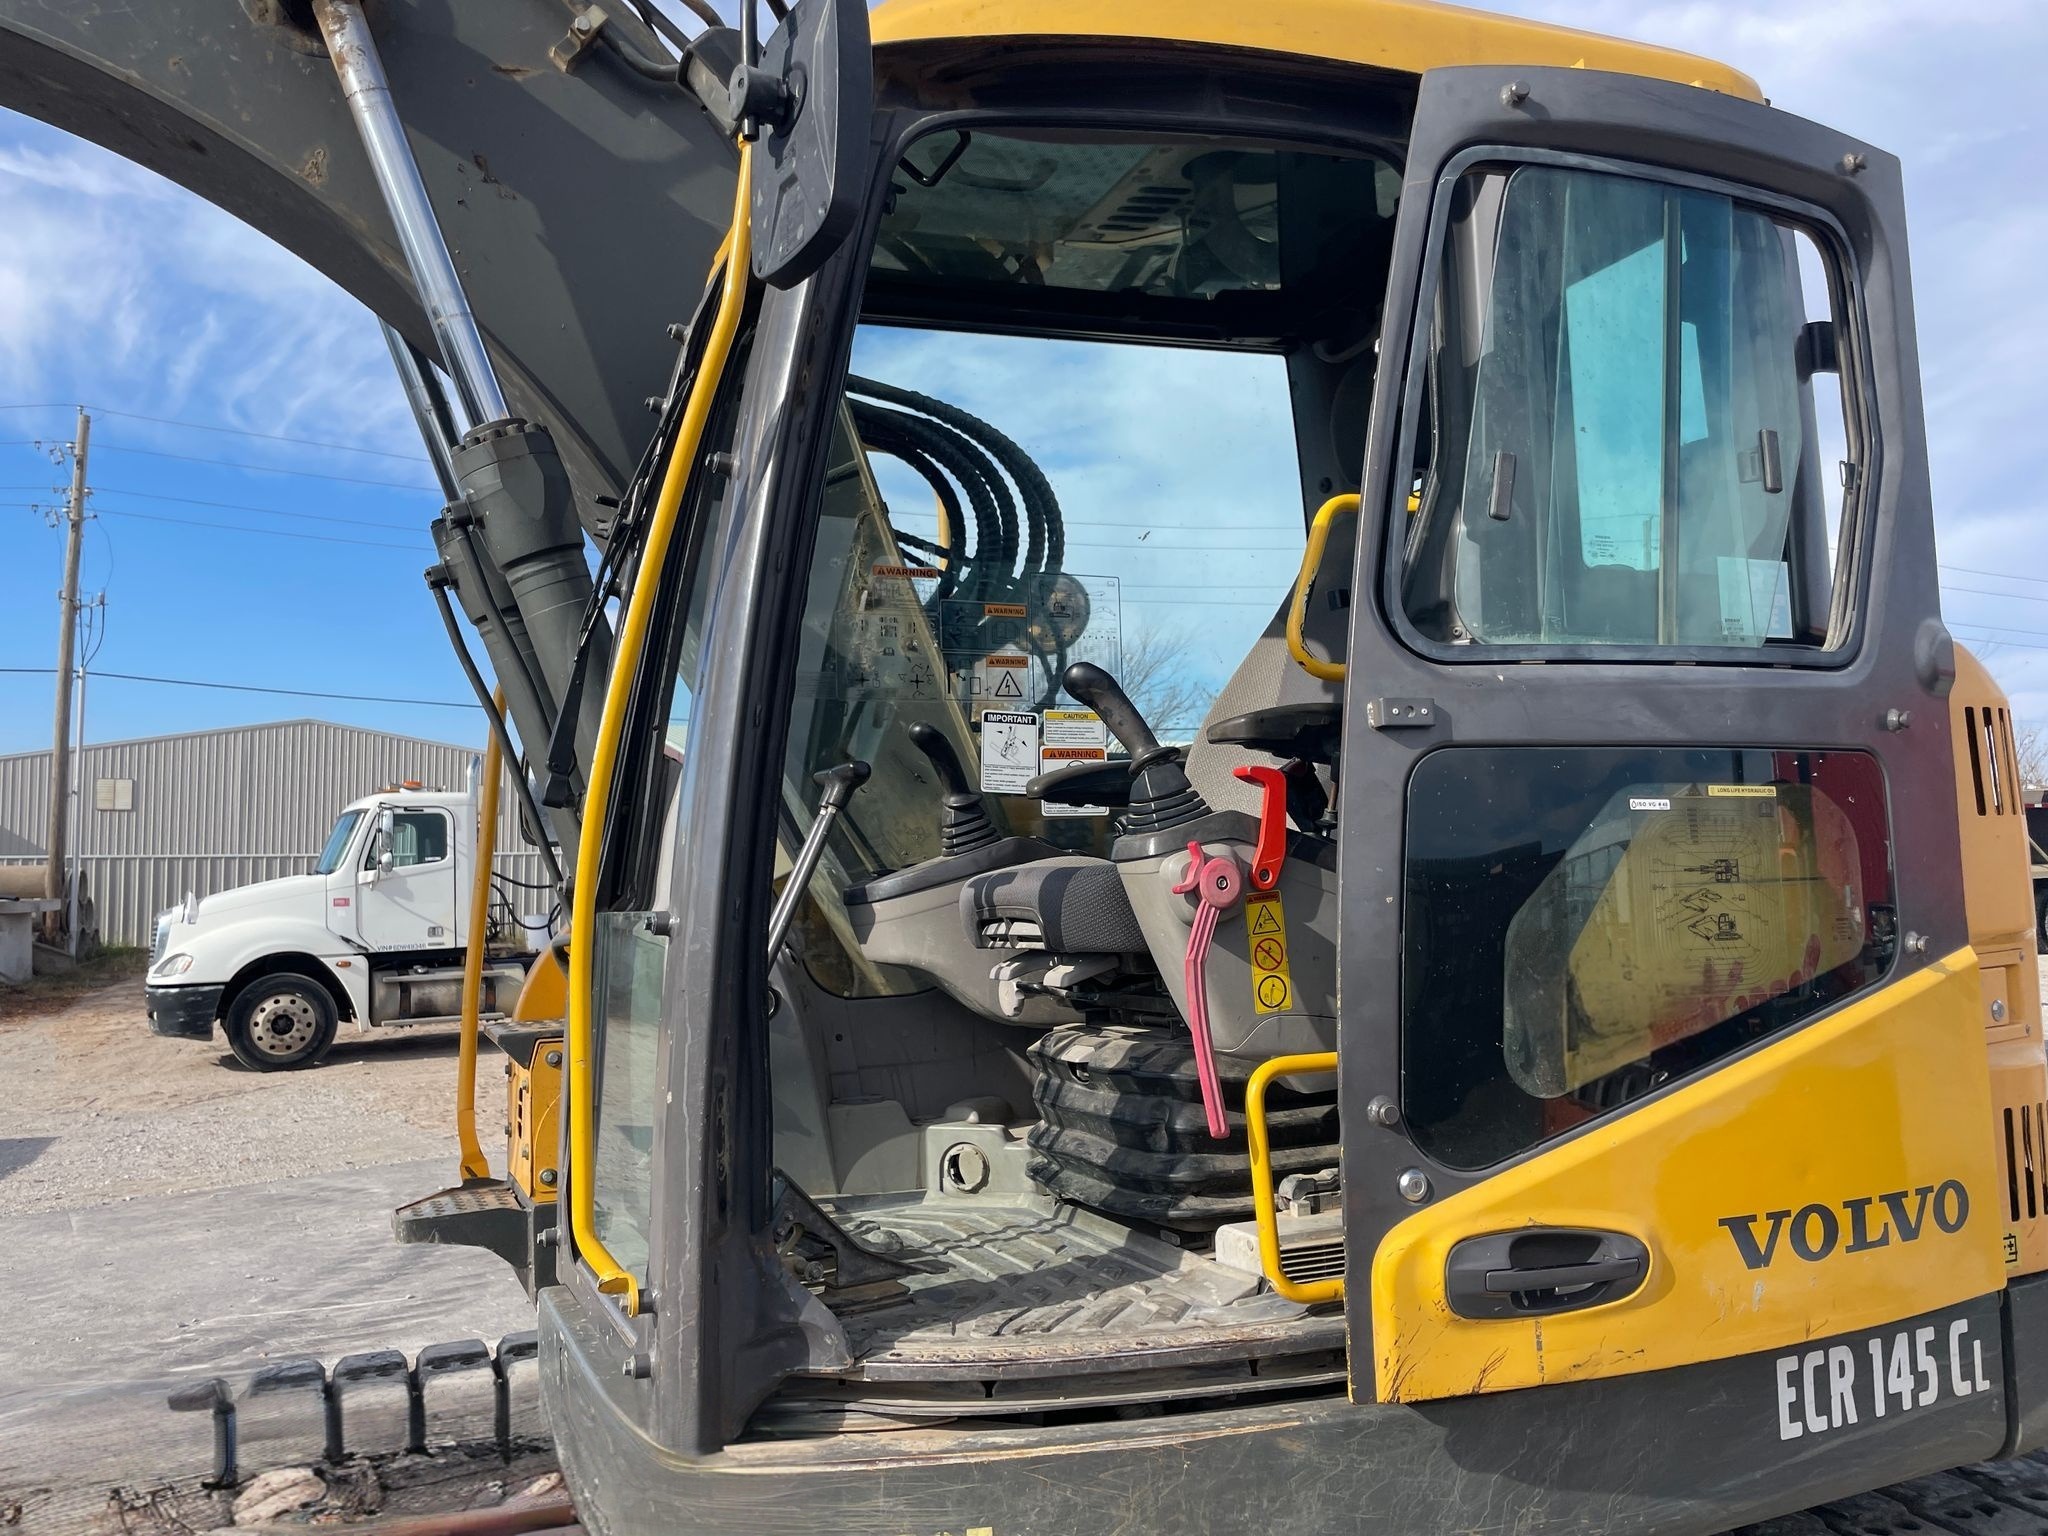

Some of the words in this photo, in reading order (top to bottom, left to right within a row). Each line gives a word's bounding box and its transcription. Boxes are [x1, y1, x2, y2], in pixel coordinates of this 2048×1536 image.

[886, 567, 934, 578] WARNING
[993, 608, 1025, 617] WARNING
[995, 656, 1027, 667] WARNING
[987, 713, 1034, 725] IMPORTANT
[1057, 750, 1098, 759] WARNING
[1718, 1179, 1970, 1270] VOLVO
[1776, 1344, 1859, 1441] ECR
[1868, 1325, 1939, 1418] 145
[1949, 1318, 1991, 1397] CL
